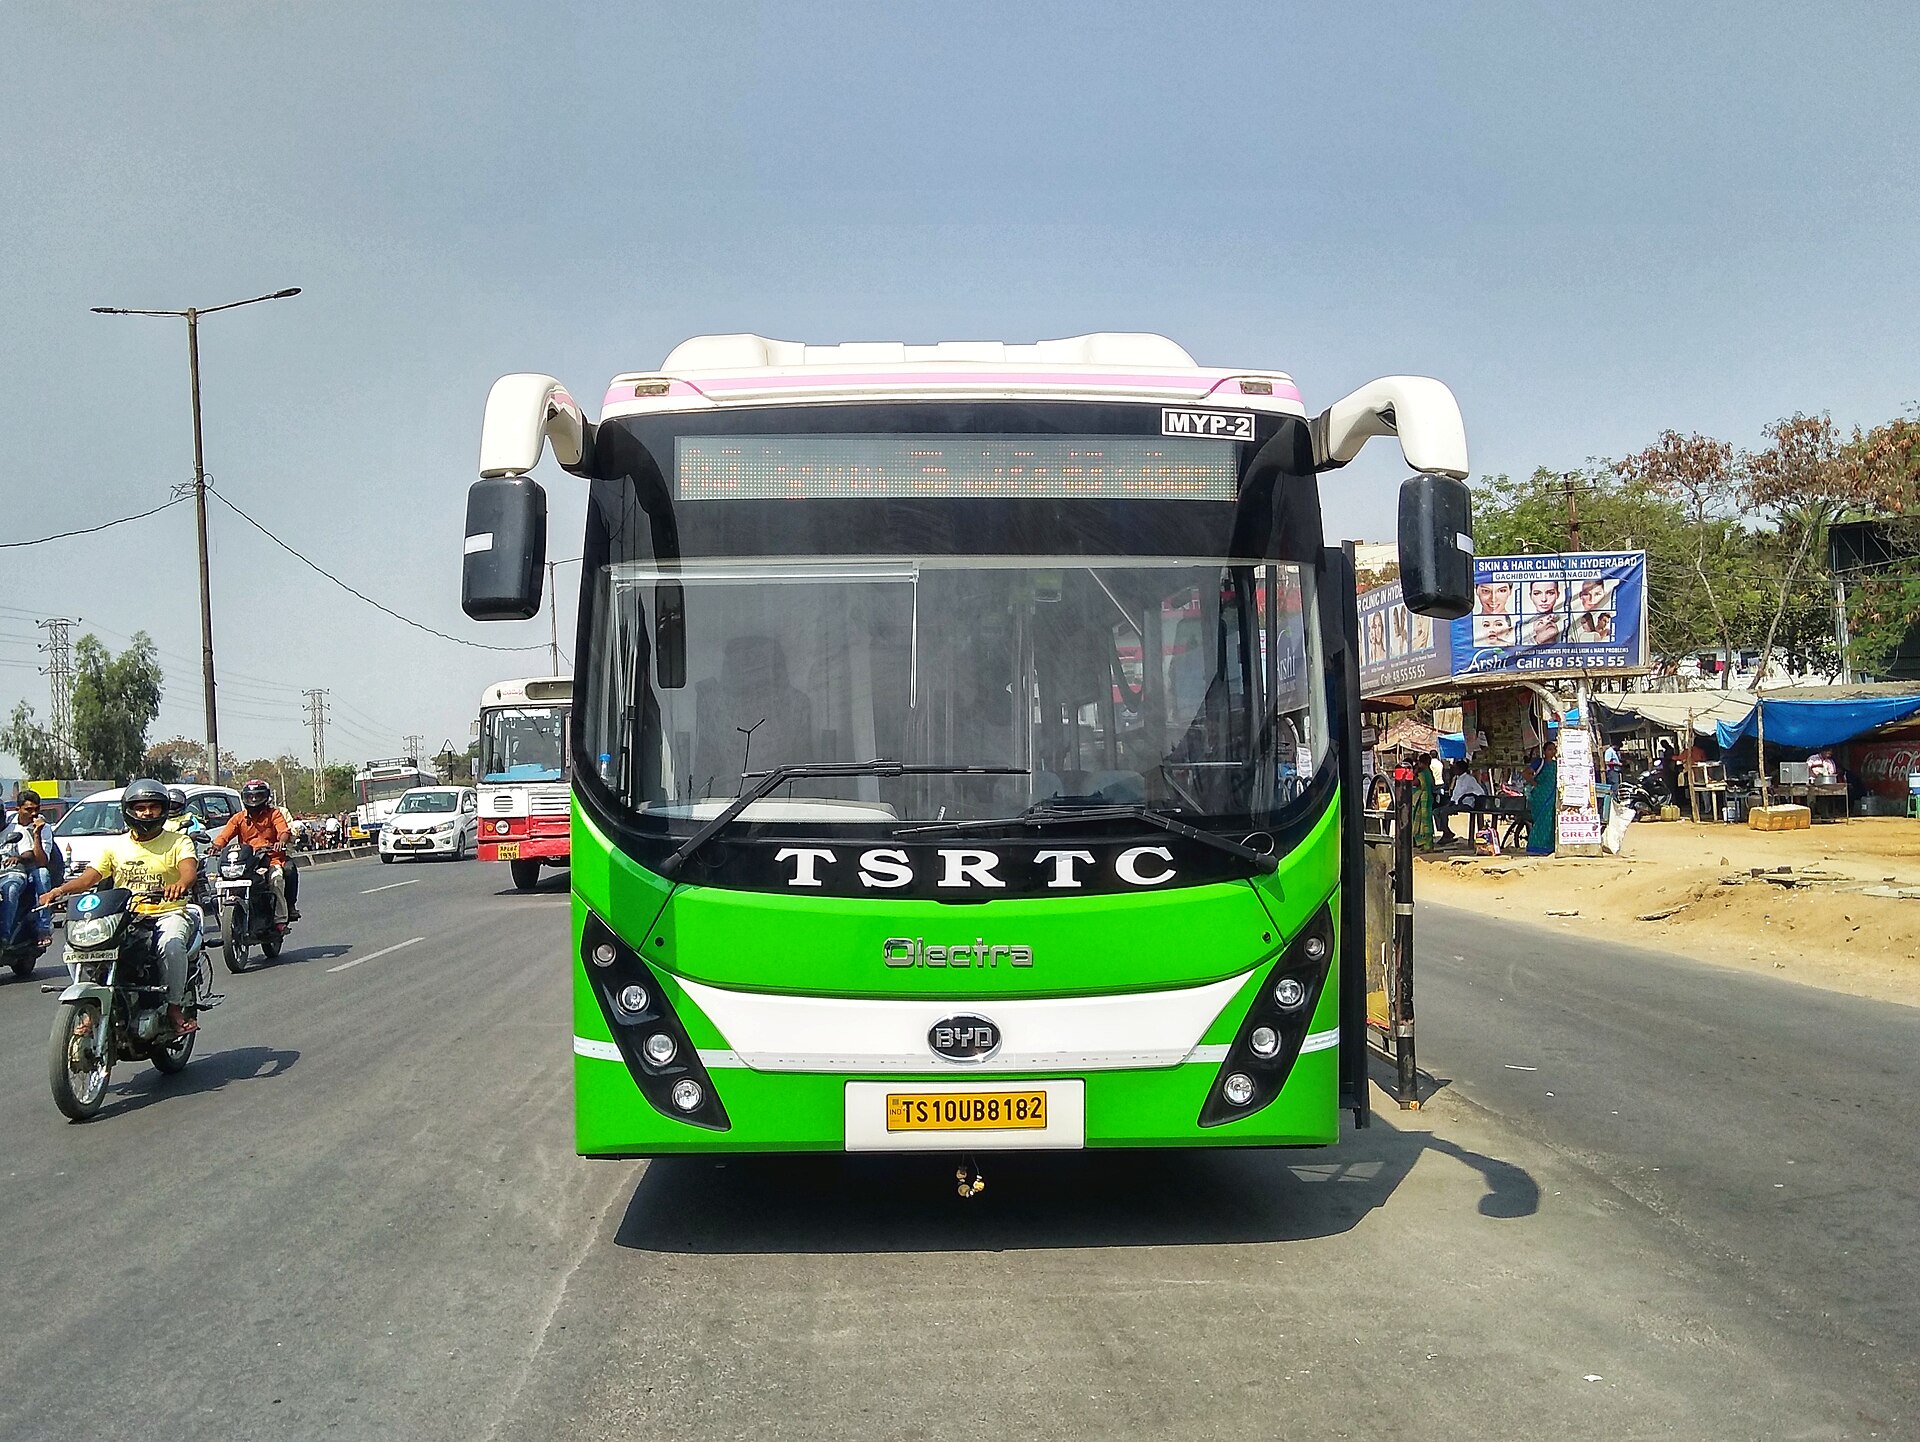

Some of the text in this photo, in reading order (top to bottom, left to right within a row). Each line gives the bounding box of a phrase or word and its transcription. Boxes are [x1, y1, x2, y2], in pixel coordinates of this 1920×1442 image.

[1168, 413, 1251, 437] MYP-2
[1478, 561, 1501, 571] SKIN
[1502, 561, 1509, 571] &
[1511, 560, 1533, 571] HAIR
[1536, 559, 1567, 570] CLINIC
[1568, 559, 1578, 569] IN
[1579, 556, 1637, 569] HYDERABAD
[1495, 572, 1543, 580] GACHIBOWLI
[1362, 594, 1380, 611] CLINIC
[1380, 590, 1387, 605] IN
[1461, 648, 1509, 673] Arshi
[1516, 655, 1625, 669] Call: 48 55 55 55
[1400, 667, 1408, 681] 55
[1409, 665, 1417, 680] 55
[1417, 664, 1426, 677] 55
[774, 846, 1177, 888] TSRTC
[883, 937, 1034, 968] Olectra
[935, 1027, 993, 1048] BYD
[889, 1108, 902, 1116] IND
[901, 1096, 1043, 1124] TS10UB8182
